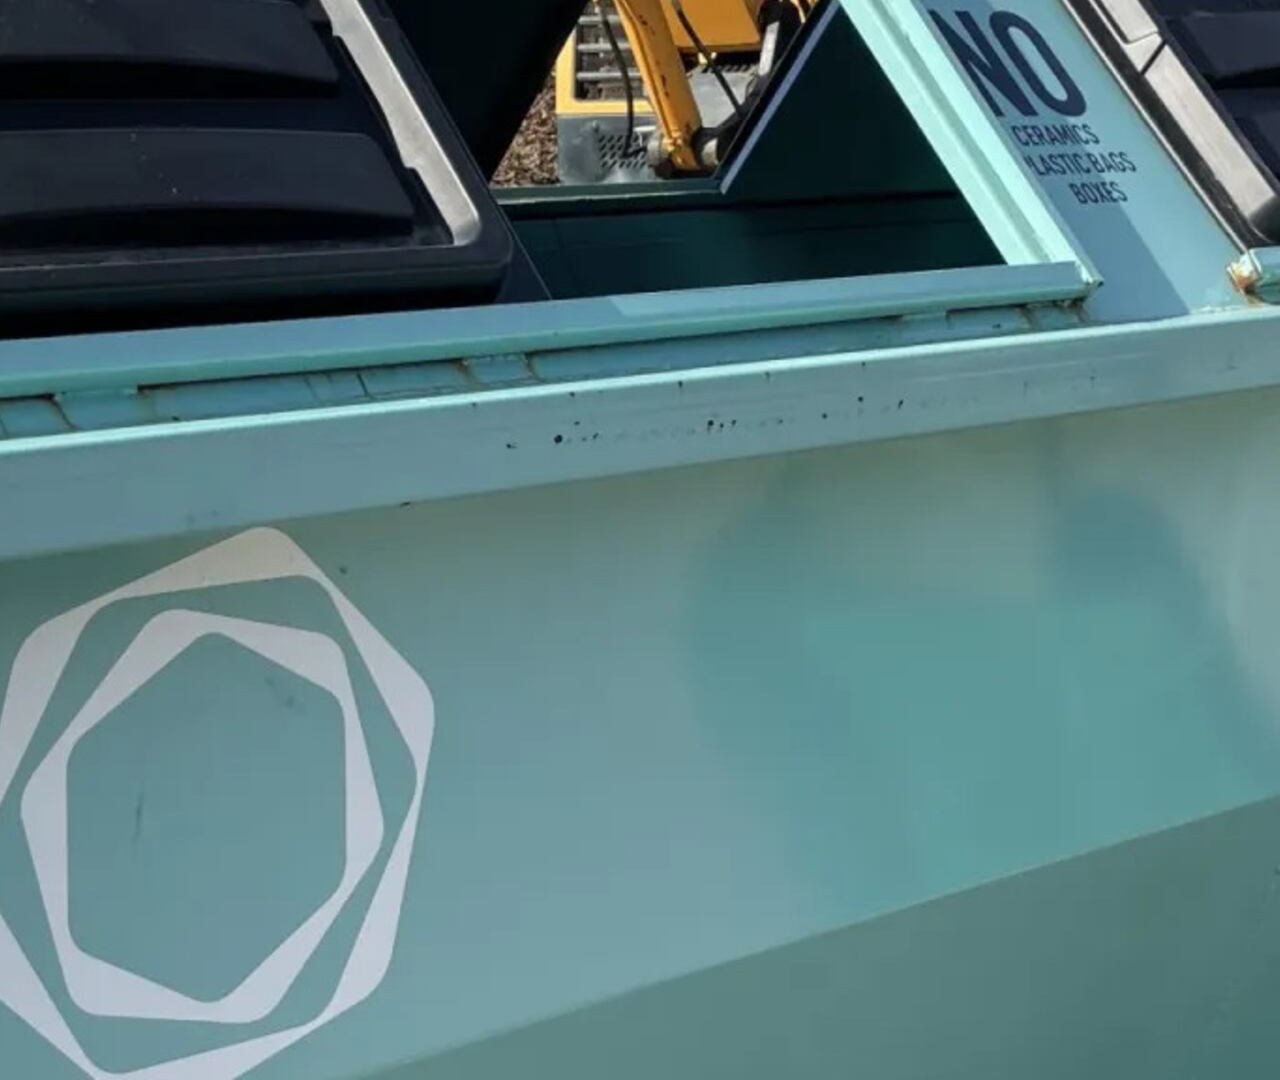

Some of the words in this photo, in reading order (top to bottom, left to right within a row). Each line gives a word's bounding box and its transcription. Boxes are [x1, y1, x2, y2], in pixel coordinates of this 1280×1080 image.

[929, 9, 1087, 117] NO
[1010, 123, 1100, 146] CERAMICS
[1086, 151, 1136, 173] BAGS
[1068, 181, 1128, 204] BOXES
